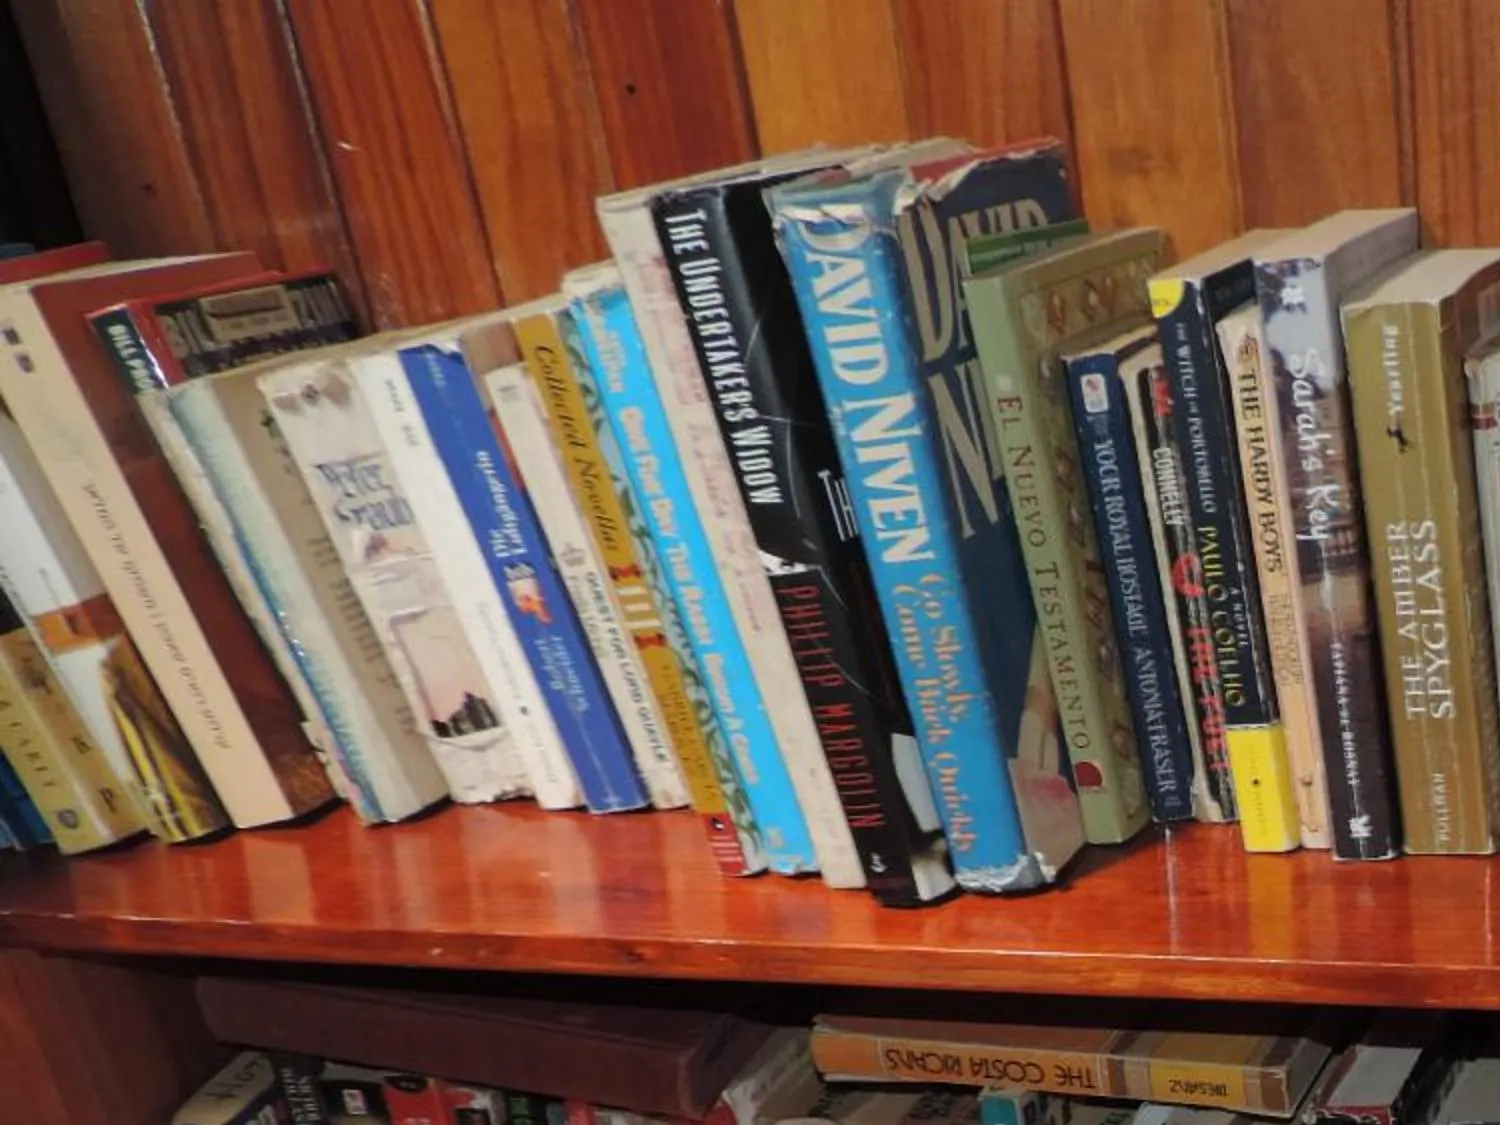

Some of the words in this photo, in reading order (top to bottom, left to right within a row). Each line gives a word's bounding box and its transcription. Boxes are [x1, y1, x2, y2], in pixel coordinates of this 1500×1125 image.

[662, 205, 714, 259] THE
[791, 193, 892, 392] DAVID
[676, 254, 765, 426] UNDERTAKER'S
[1381, 323, 1404, 416] Yearling
[996, 393, 1026, 432] EL
[1236, 368, 1262, 423] THE
[1285, 346, 1337, 473] Sarah's
[729, 421, 793, 511] WIDOW
[840, 388, 936, 569] NIVEN
[1006, 442, 1052, 550] NUEVO
[1150, 445, 1184, 528] CONNELLY
[1244, 424, 1274, 507] HARDY
[1257, 511, 1283, 574] BOYS
[1291, 483, 1344, 542] Key
[1195, 524, 1229, 603] PAULO
[1385, 519, 1420, 642] AMBER
[1032, 560, 1096, 751] TESTAMENTO
[1208, 608, 1246, 709] COELHO
[1409, 517, 1456, 720] SPYGLASS
[776, 579, 848, 694] PHILIP
[812, 697, 888, 835] MARGOLIN
[1398, 653, 1428, 720] THE
[967, 1054, 1047, 1085] COSTA
[1051, 1063, 1096, 1090] THE
